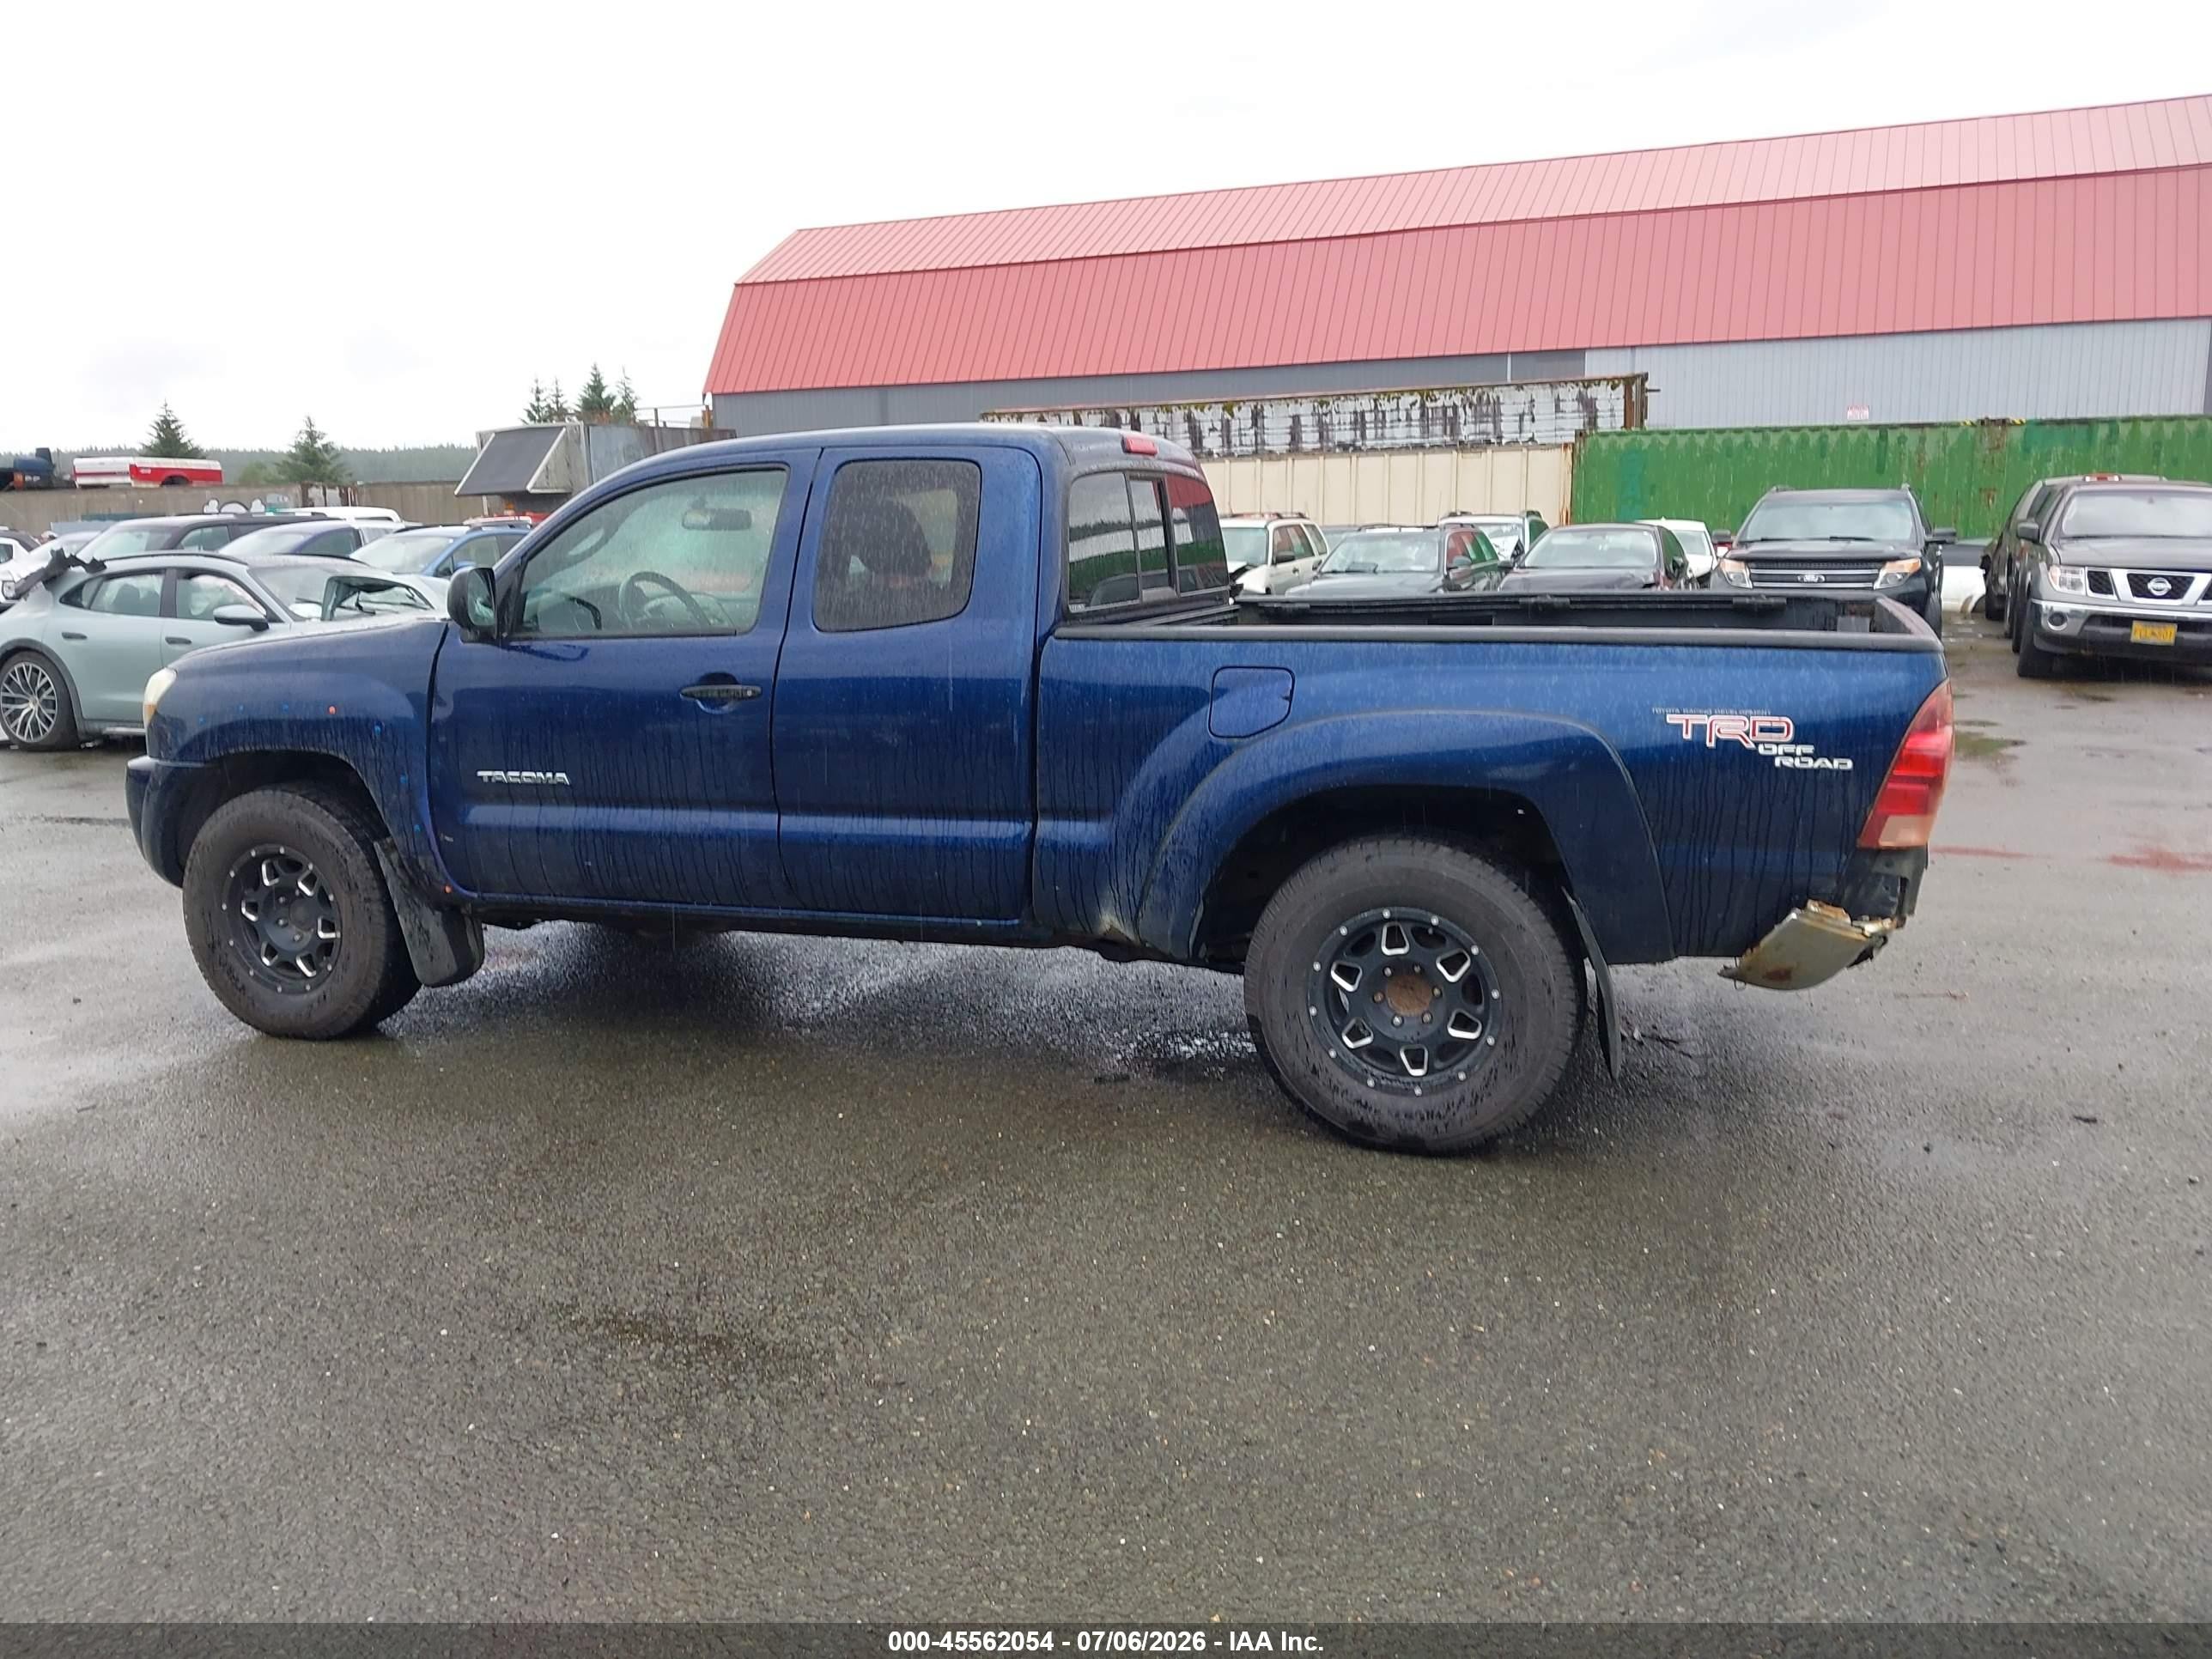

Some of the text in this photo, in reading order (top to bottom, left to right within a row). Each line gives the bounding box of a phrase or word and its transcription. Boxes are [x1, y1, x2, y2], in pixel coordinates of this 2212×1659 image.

[1666, 714, 1795, 749] TRD
[1758, 743, 1815, 756] OFF
[1774, 756, 1854, 770] ROAD
[476, 769, 570, 786] TACOMA
